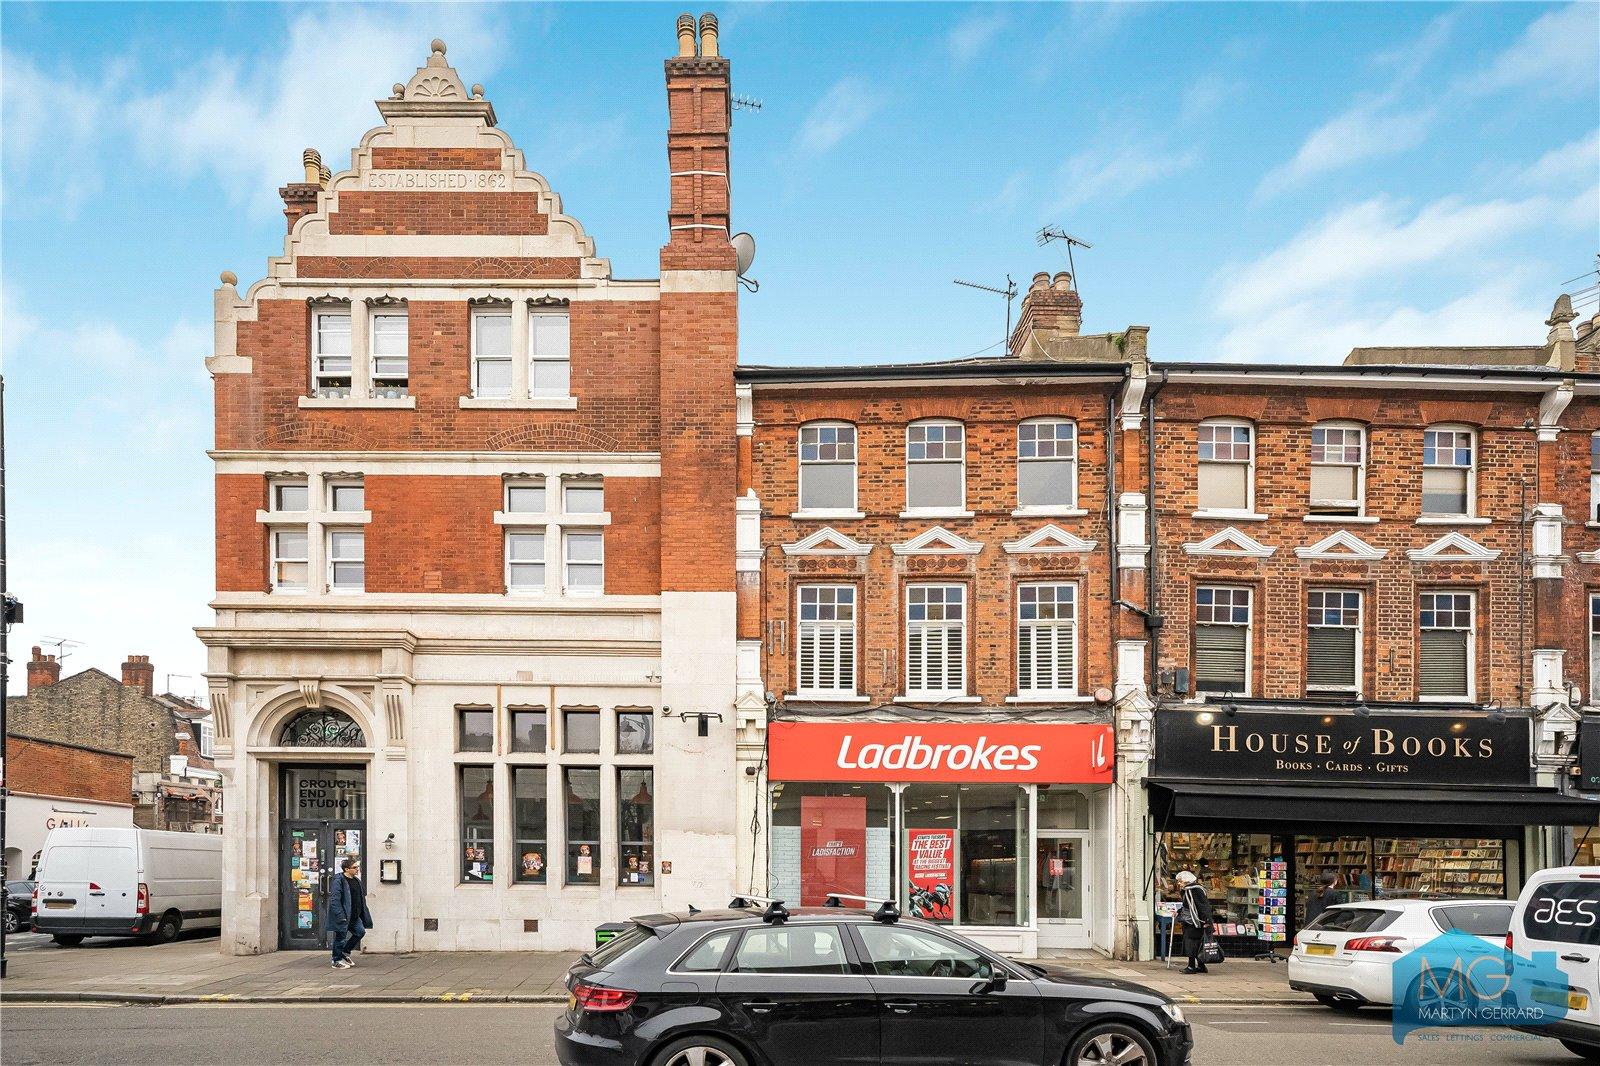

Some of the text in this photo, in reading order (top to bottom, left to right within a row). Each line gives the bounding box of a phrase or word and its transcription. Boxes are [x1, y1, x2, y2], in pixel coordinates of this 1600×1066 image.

[368, 173, 506, 189] ESTABLISHED 1862
[1210, 725, 1493, 758] HOUSE of BOOKS
[836, 735, 1042, 770] Ladbrokes
[1275, 759, 1409, 773] BOOKS CARDS GIFTS
[299, 779, 357, 789] CROUCH
[299, 789, 326, 798] END
[299, 799, 349, 808] STUDIO
[914, 839, 950, 850] THE BEST
[919, 849, 944, 859] VALUE
